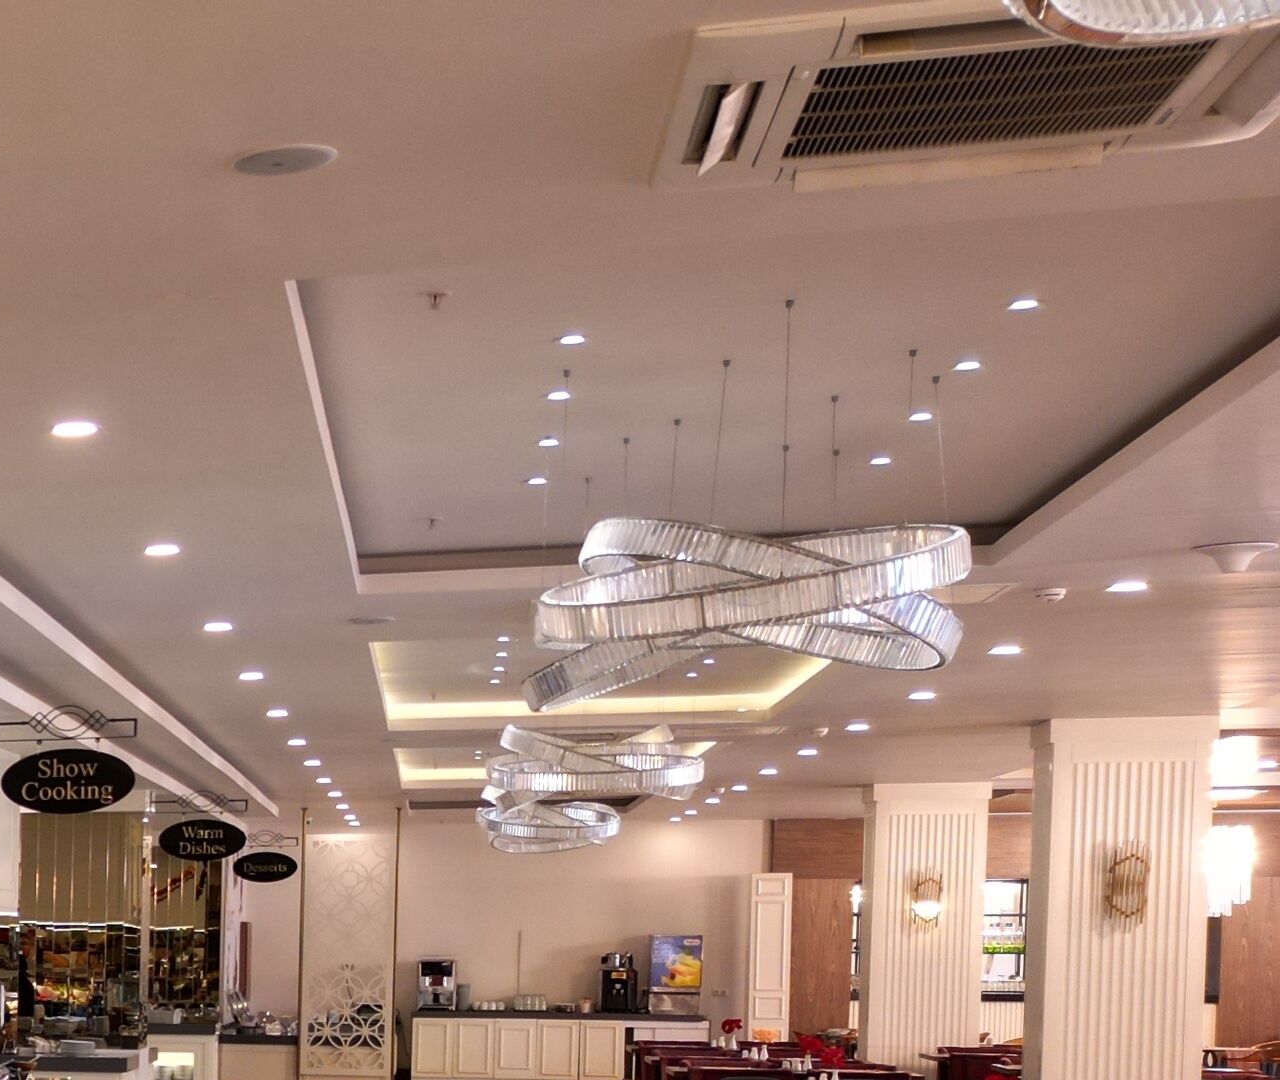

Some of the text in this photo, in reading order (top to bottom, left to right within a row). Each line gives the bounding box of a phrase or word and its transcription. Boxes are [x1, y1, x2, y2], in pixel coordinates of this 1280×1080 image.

[37, 758, 99, 779] Show
[21, 780, 114, 805] Cooking
[181, 826, 224, 839] Warm
[178, 841, 227, 855] Dishes
[243, 862, 288, 873] Desserts
